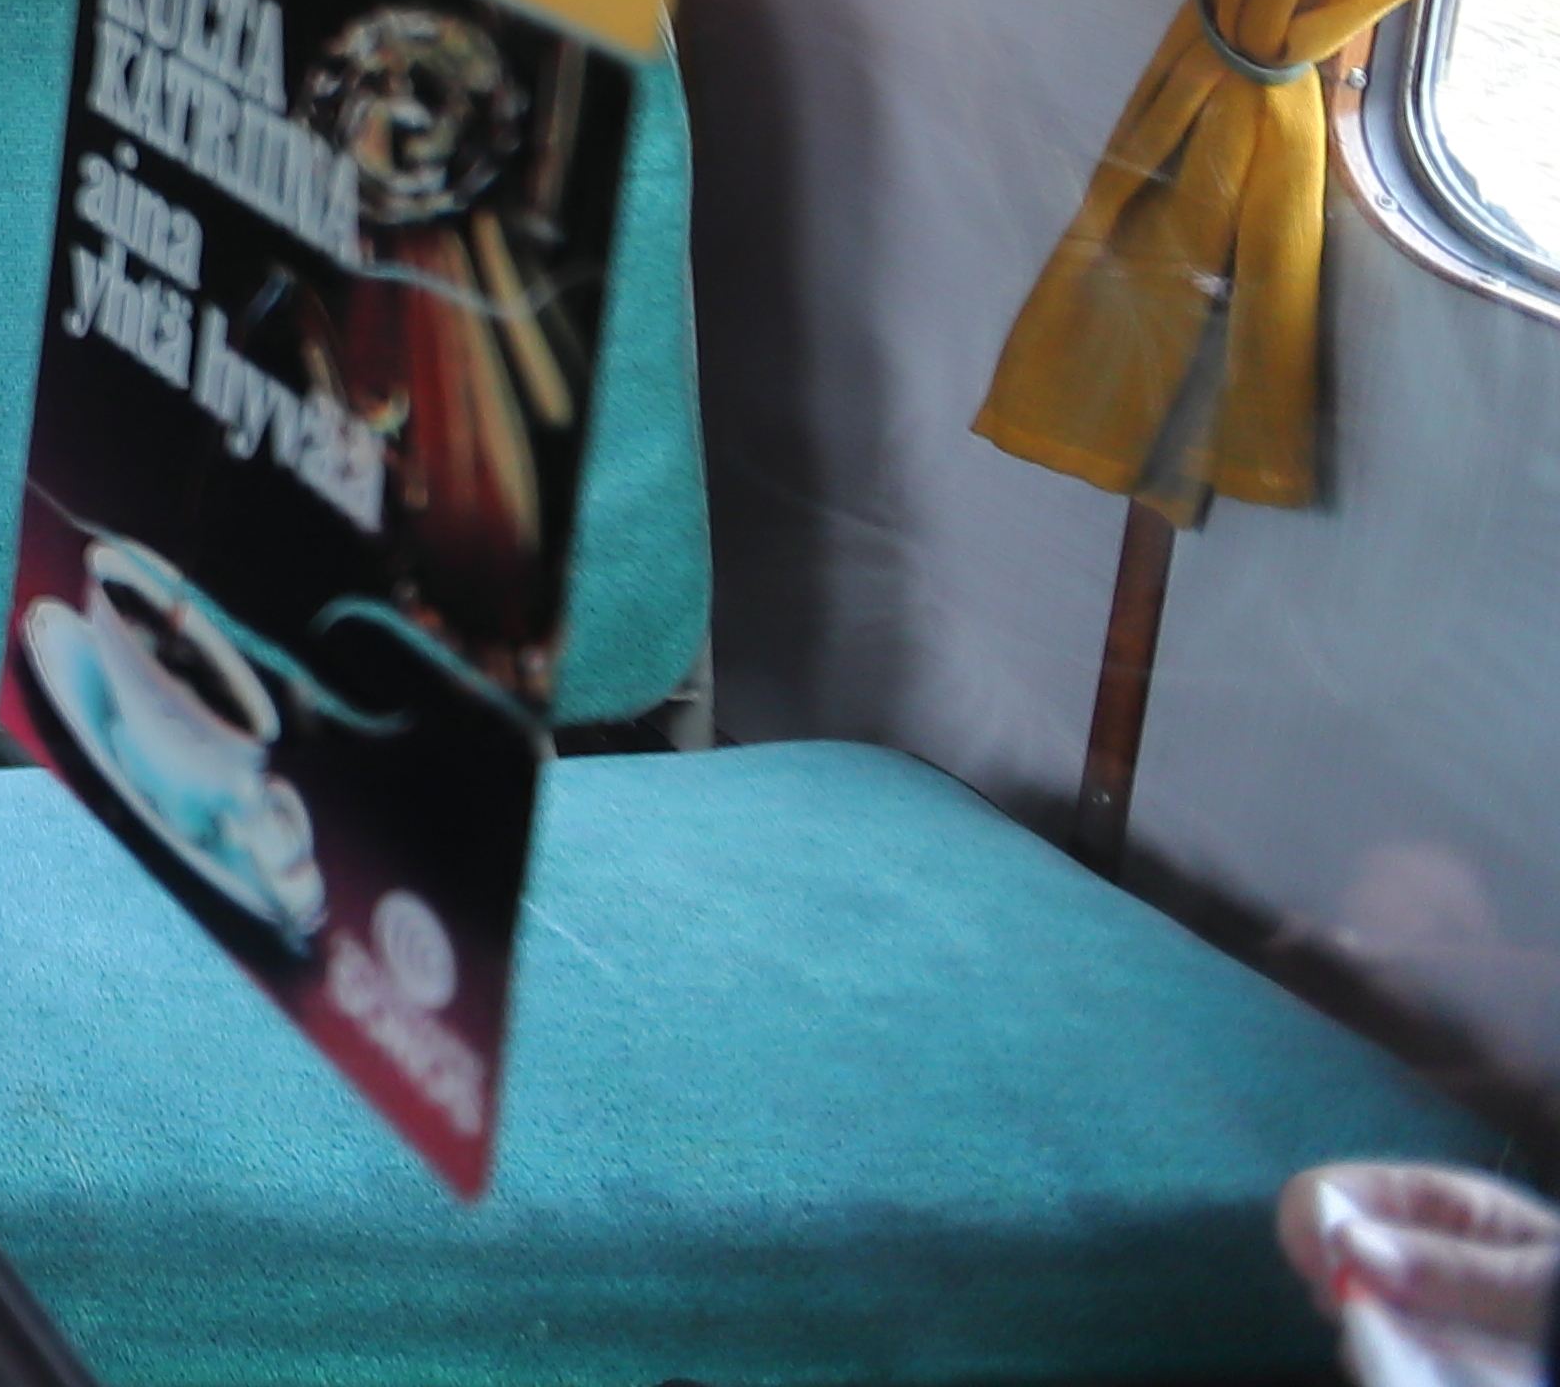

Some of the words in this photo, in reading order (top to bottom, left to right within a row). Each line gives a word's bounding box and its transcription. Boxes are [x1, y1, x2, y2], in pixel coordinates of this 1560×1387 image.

[76, 143, 202, 287] aina
[90, 22, 362, 269] KATRIINA
[65, 239, 194, 388] yhtä
[193, 300, 385, 531] hyvää
